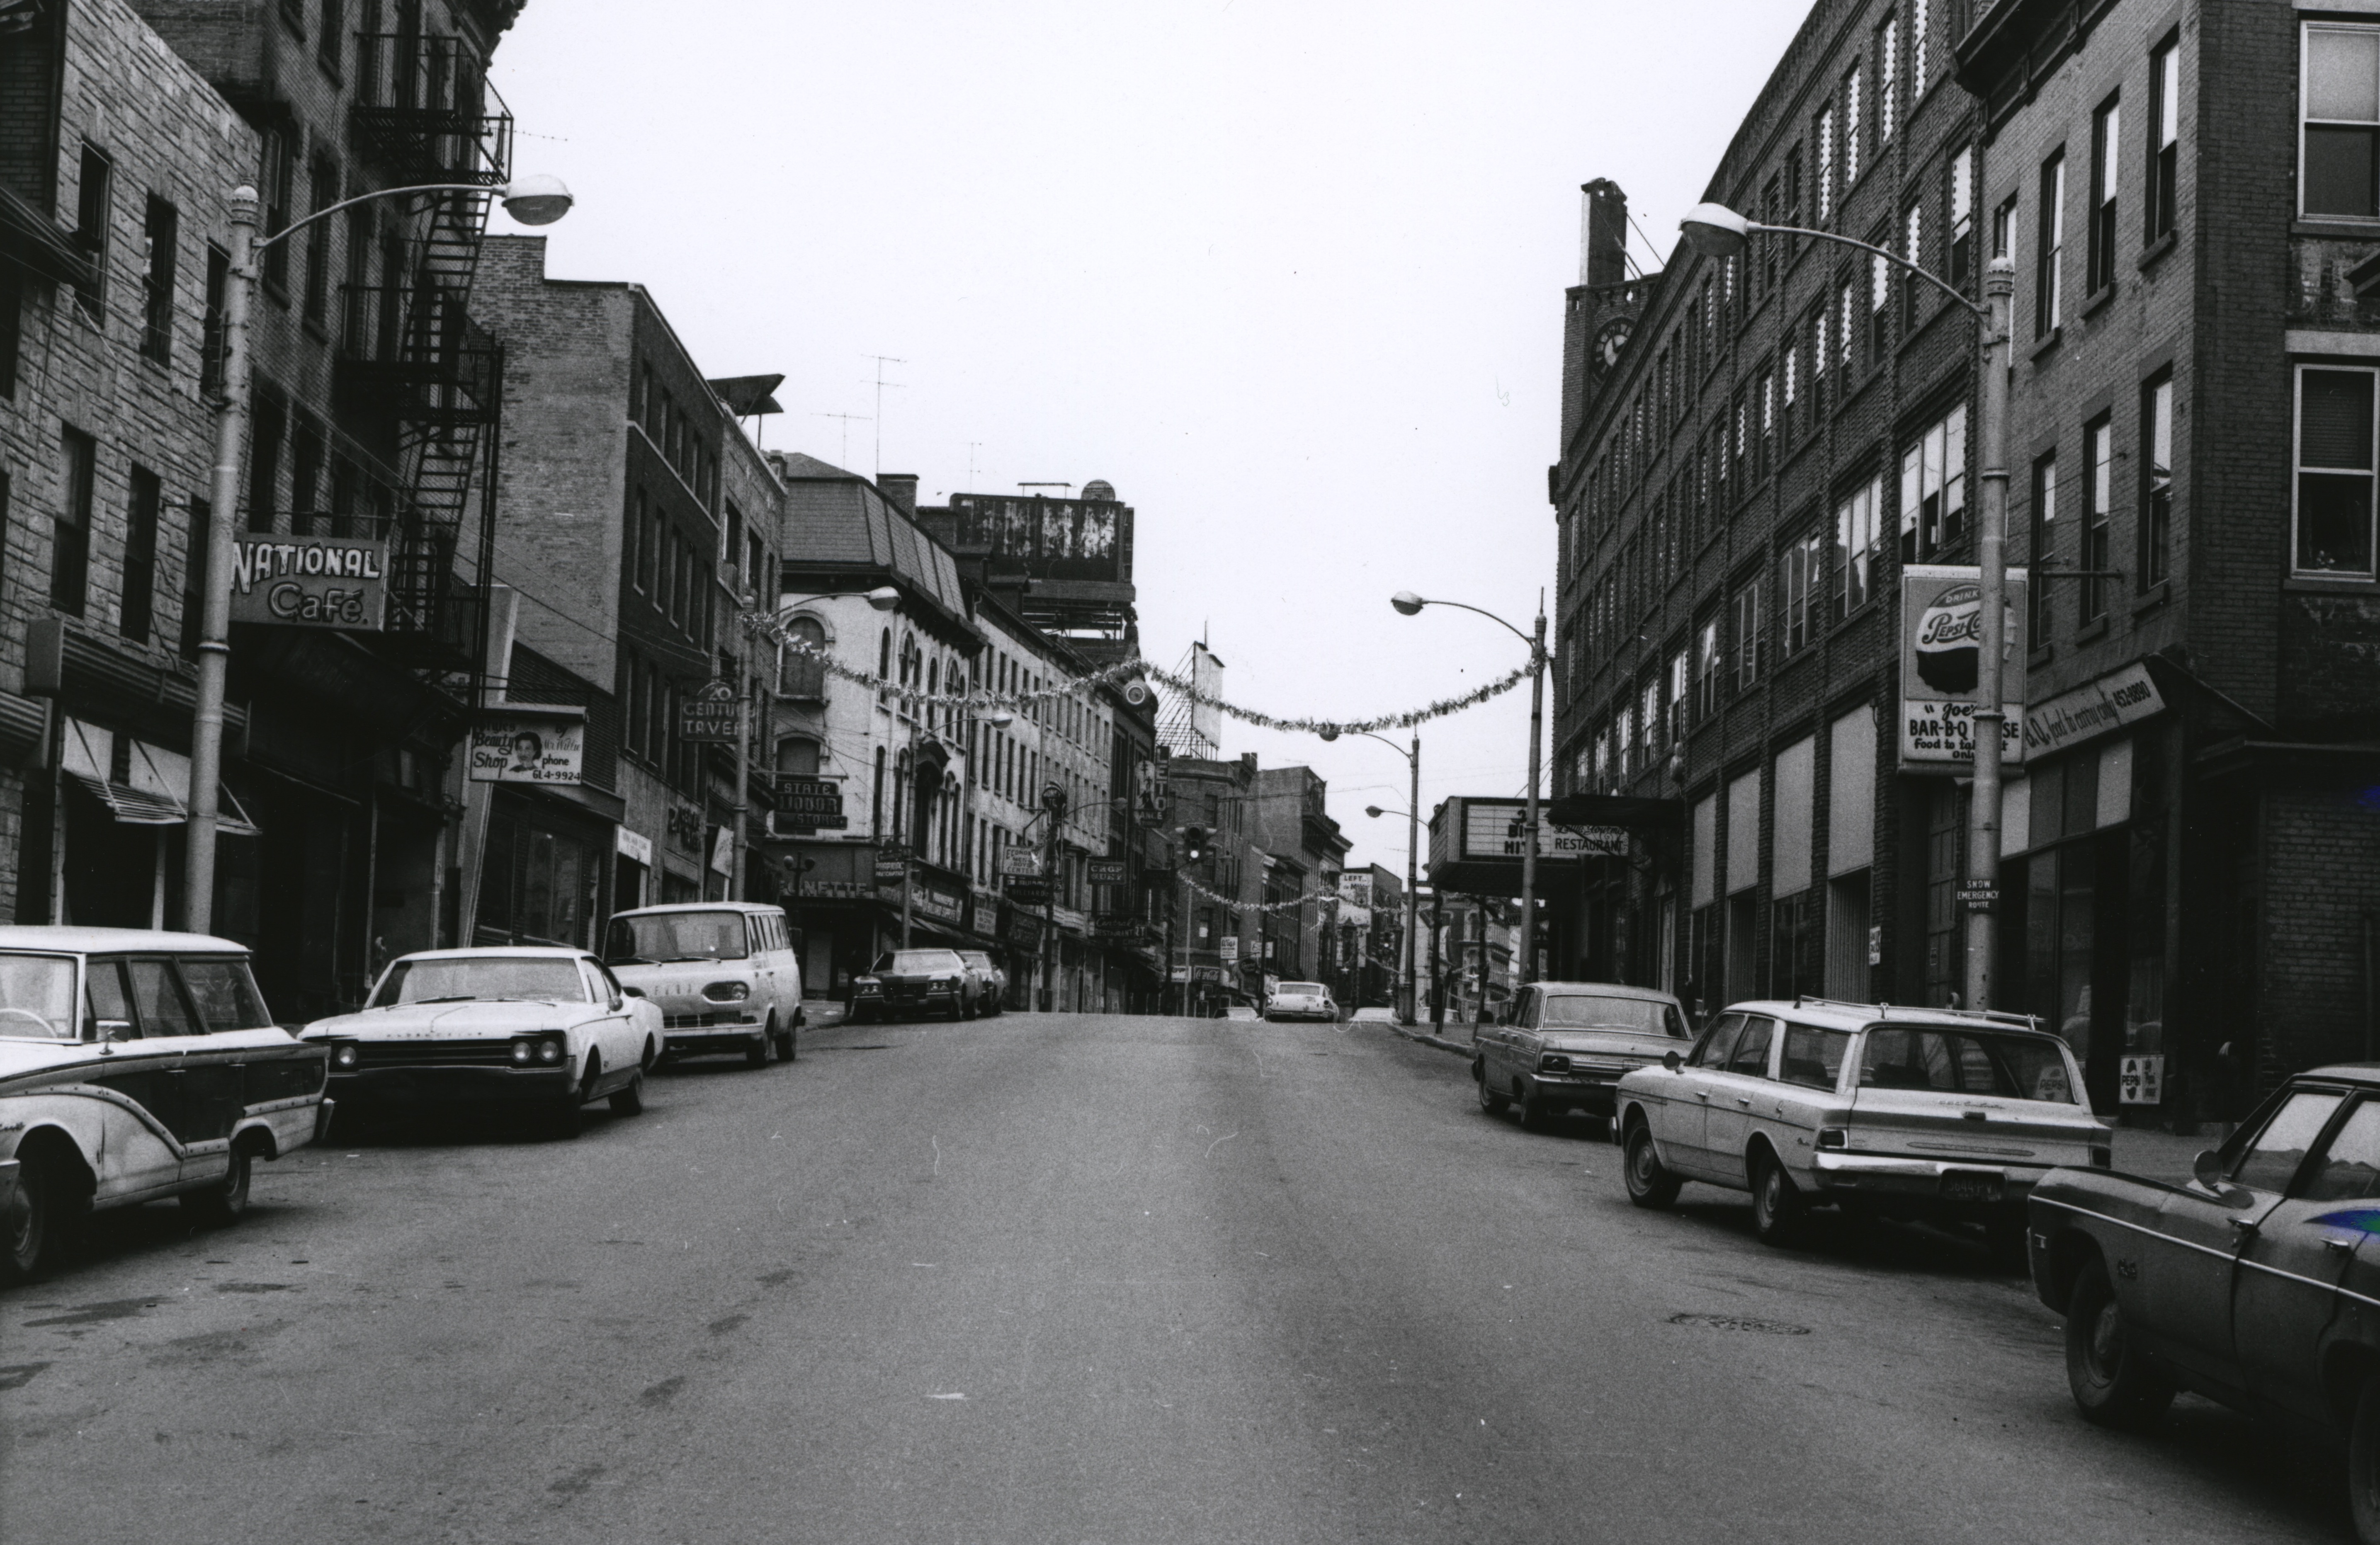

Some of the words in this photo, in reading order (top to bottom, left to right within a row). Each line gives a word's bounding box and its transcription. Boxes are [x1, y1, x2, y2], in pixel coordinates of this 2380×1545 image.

[231, 541, 381, 594] NATIONAL
[269, 582, 364, 623] Café
[1945, 589, 1979, 604] DRINK
[555, 723, 568, 738] By
[1909, 719, 1968, 741] BAR-B-Q
[473, 732, 515, 755] Beauty
[1914, 738, 1941, 749] Food
[1944, 739, 1956, 749] to
[473, 752, 508, 779] Shop
[542, 753, 569, 769] phone
[784, 783, 831, 795] STATE
[779, 795, 838, 813] LIQUOR
[797, 814, 838, 825] STORE
[1555, 838, 1623, 852] RESTAURANT
[1967, 880, 1991, 889] SNOW
[1957, 890, 2000, 900] EMERGENCY
[1096, 917, 1133, 927] Central
[2122, 1075, 2141, 1086] PEPSI
